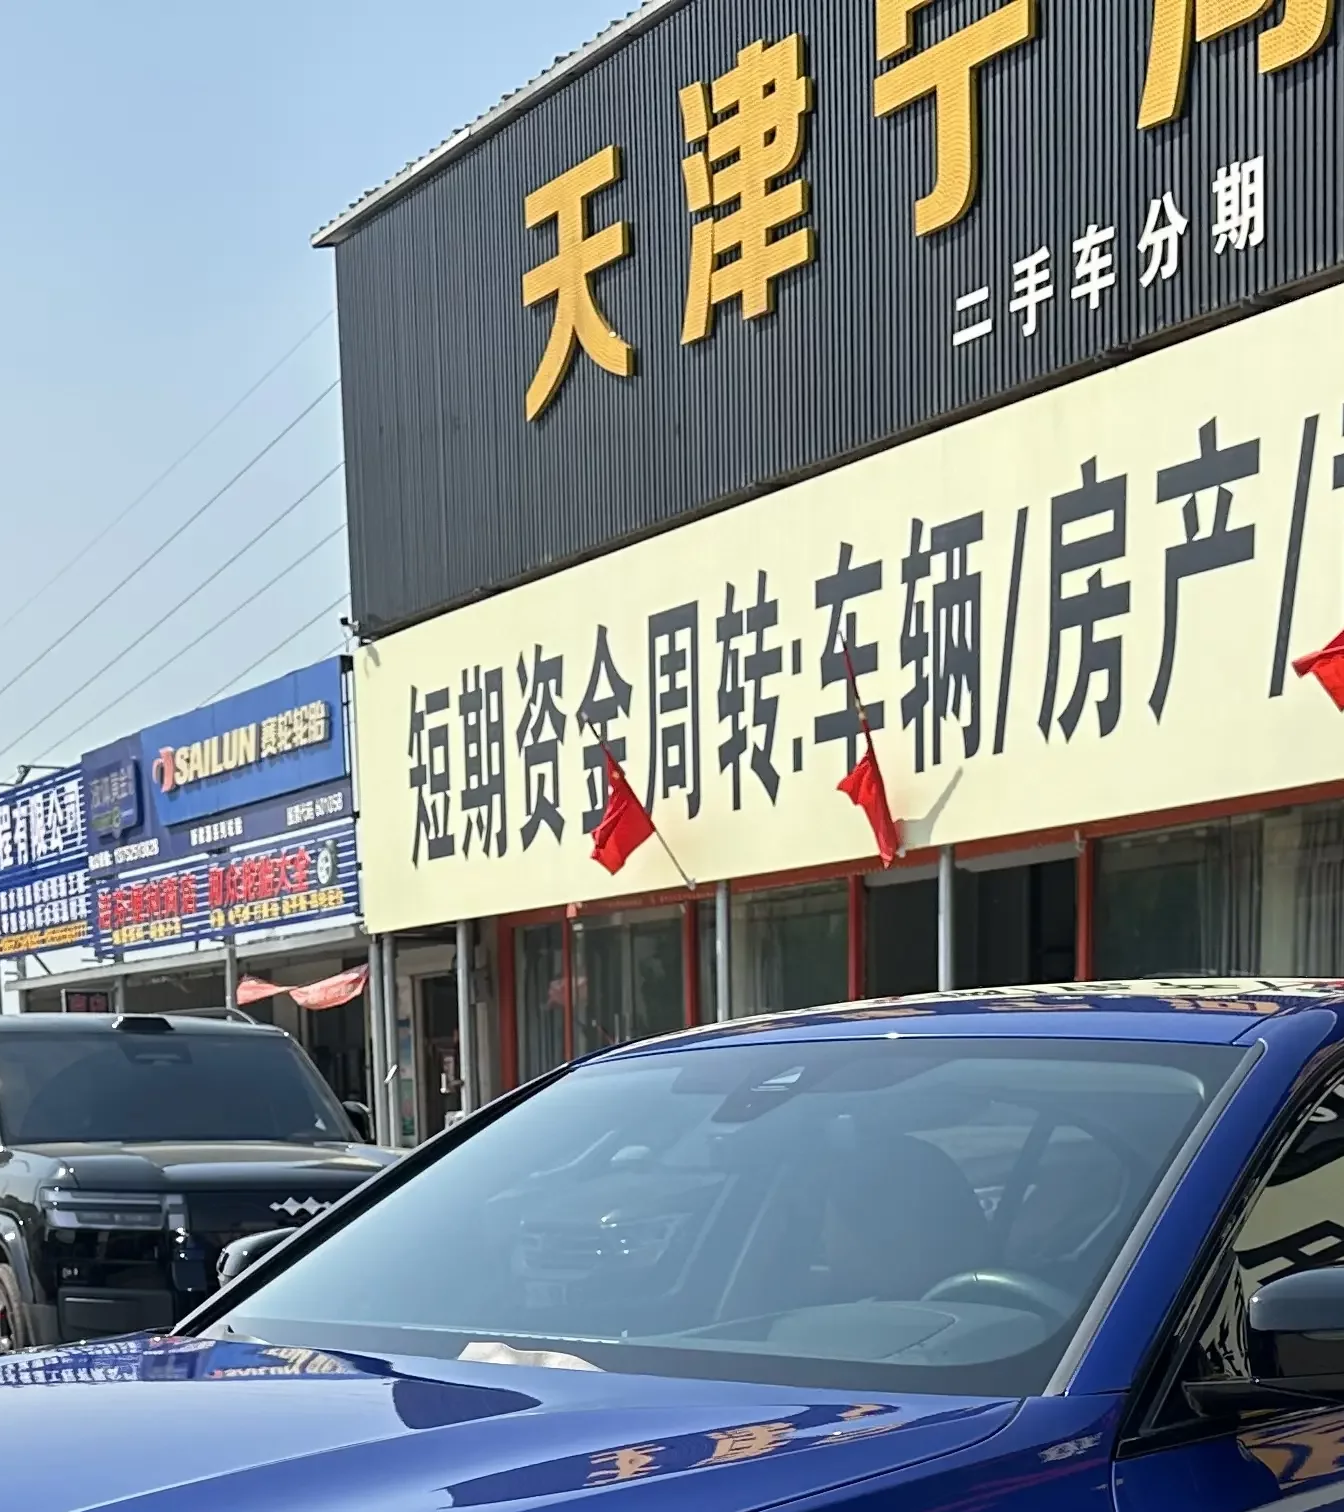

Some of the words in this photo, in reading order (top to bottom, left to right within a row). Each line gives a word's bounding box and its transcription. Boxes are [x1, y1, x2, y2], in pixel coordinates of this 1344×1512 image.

[952, 156, 1266, 347] 二手车分期
[174, 722, 257, 786] SAILUN
